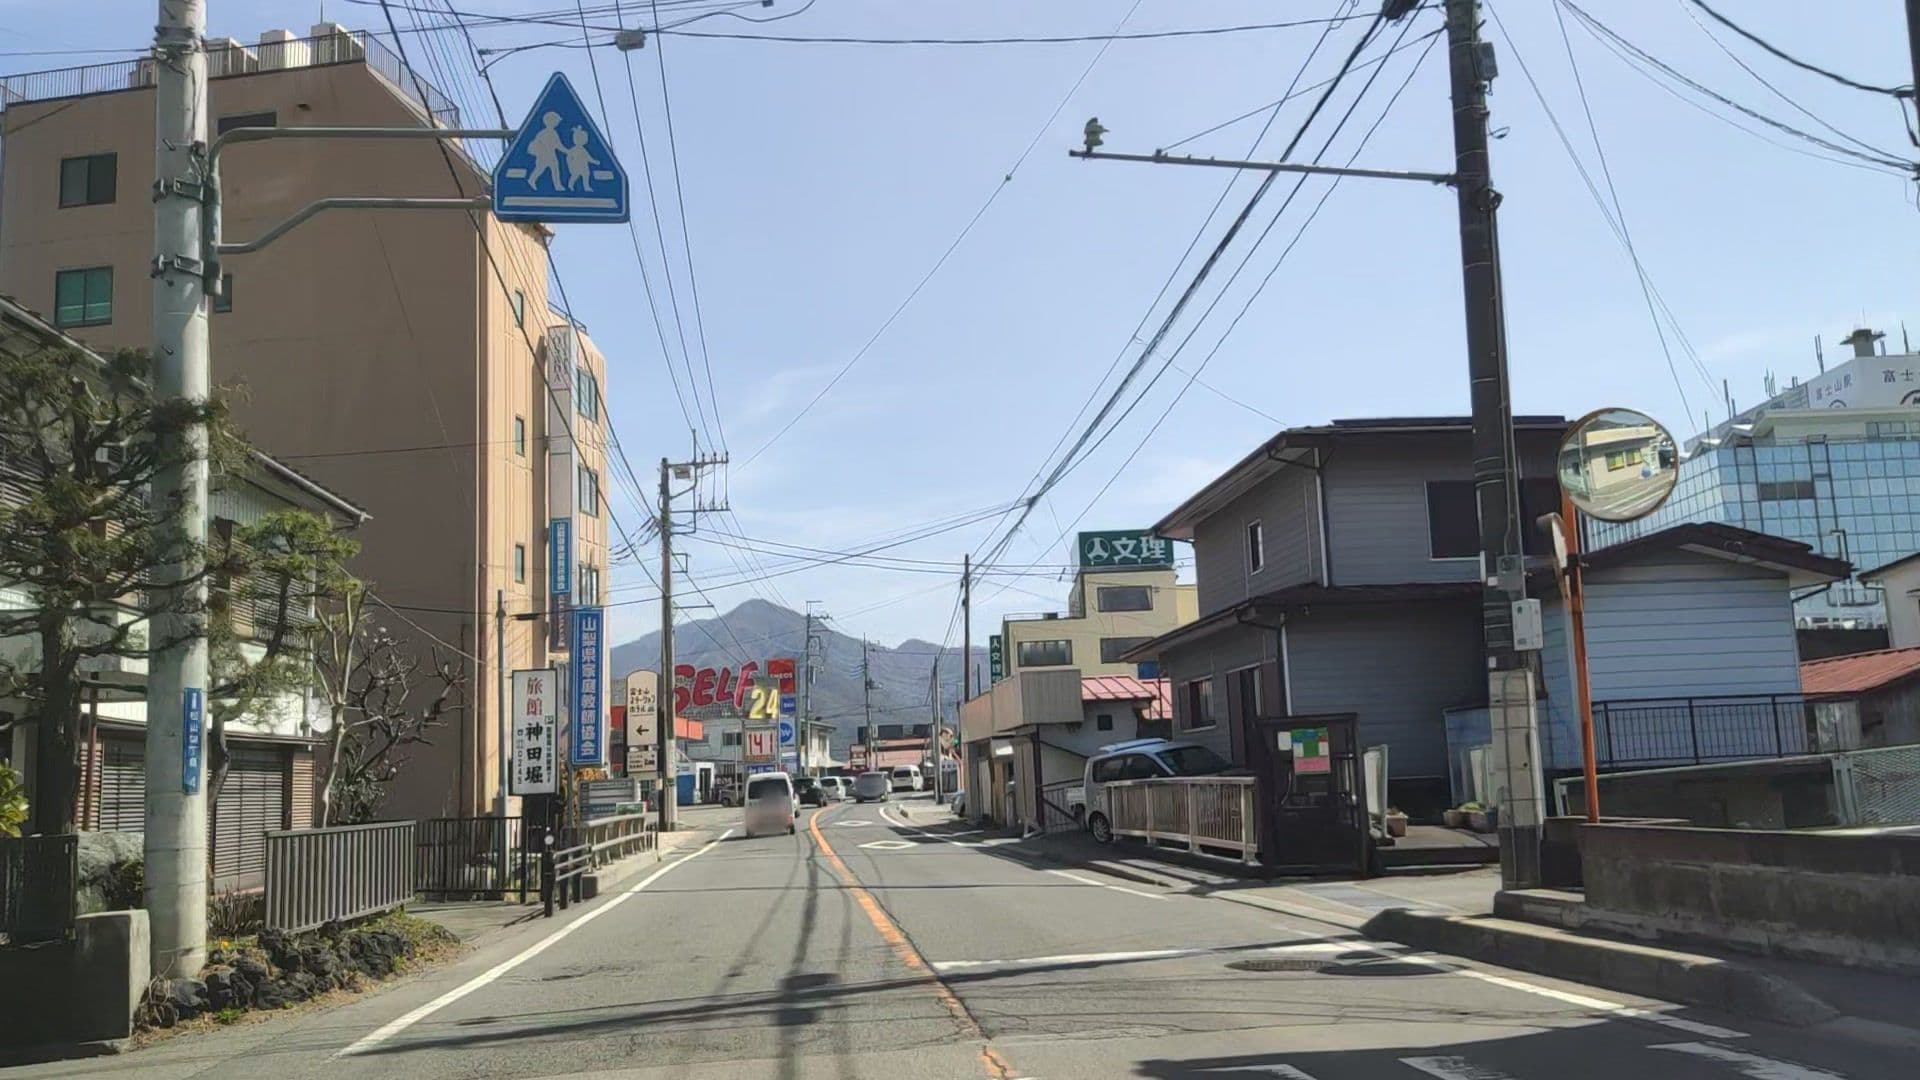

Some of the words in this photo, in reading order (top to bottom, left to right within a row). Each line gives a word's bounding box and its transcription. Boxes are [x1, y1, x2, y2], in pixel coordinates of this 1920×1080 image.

[1882, 369, 1920, 383] 富士
[1111, 536, 1166, 559] 文理
[674, 661, 758, 714] SELF
[749, 687, 779, 719] 24
[748, 732, 773, 754] 141
